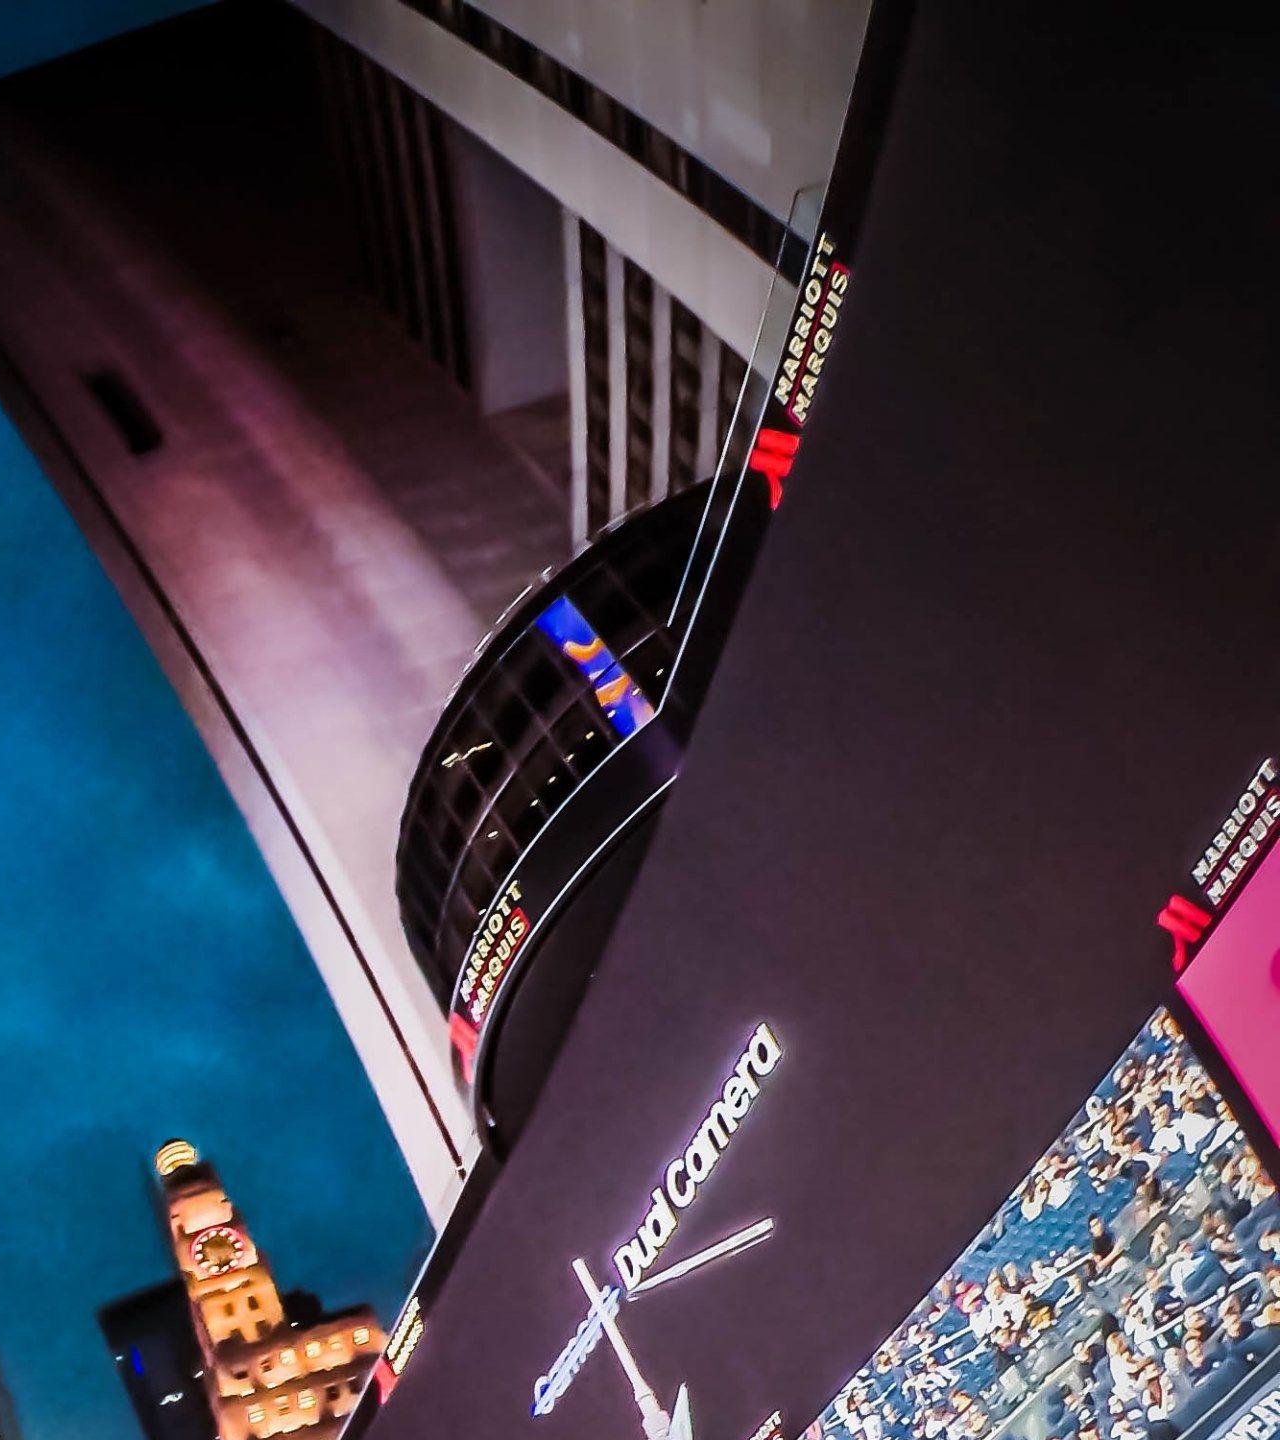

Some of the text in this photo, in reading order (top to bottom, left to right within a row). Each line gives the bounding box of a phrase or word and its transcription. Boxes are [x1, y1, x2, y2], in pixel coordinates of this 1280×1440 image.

[775, 231, 837, 406] MARRIOTT
[791, 268, 849, 423] MARQUIS
[1190, 757, 1276, 886] MARRIOTT
[459, 879, 522, 1003] MARRIOTT
[470, 915, 526, 1023] MARQUIS
[613, 1021, 785, 1292] Dual Camera
